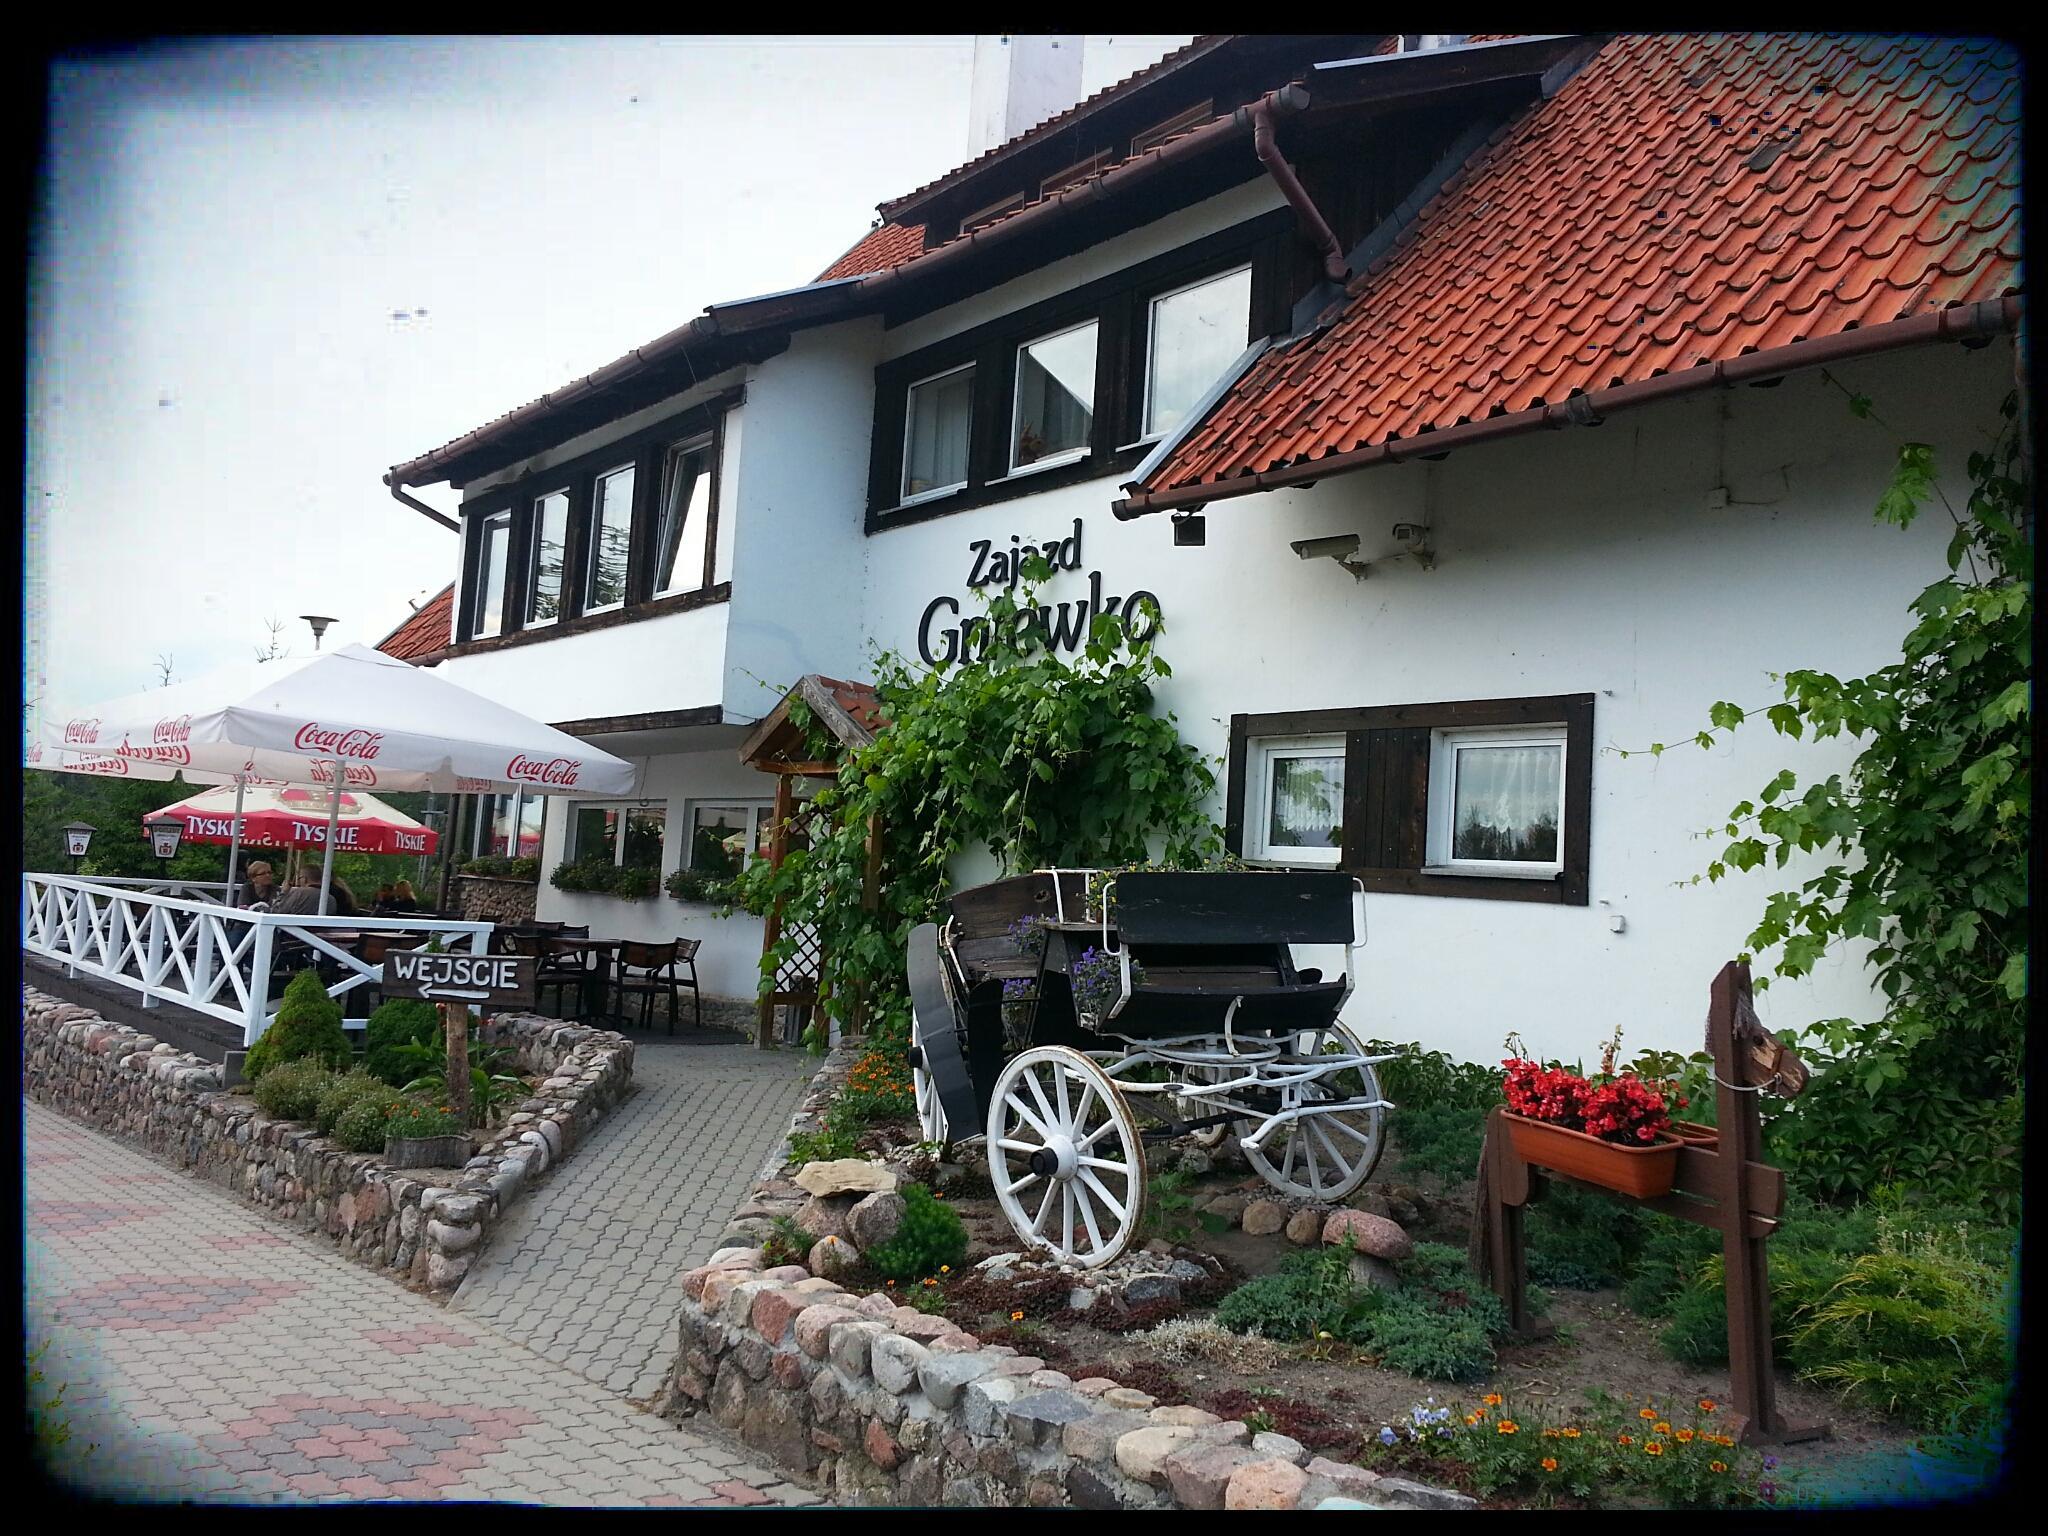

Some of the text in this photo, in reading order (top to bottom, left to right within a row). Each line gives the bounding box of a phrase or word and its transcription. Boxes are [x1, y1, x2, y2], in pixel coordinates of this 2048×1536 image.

[966, 517, 1083, 590] Zajazd
[295, 722, 386, 760] Coca-Cola
[507, 754, 582, 786] Coca-Cola
[395, 830, 427, 851] TYSKIE
[394, 955, 519, 989] WEJSCIE
